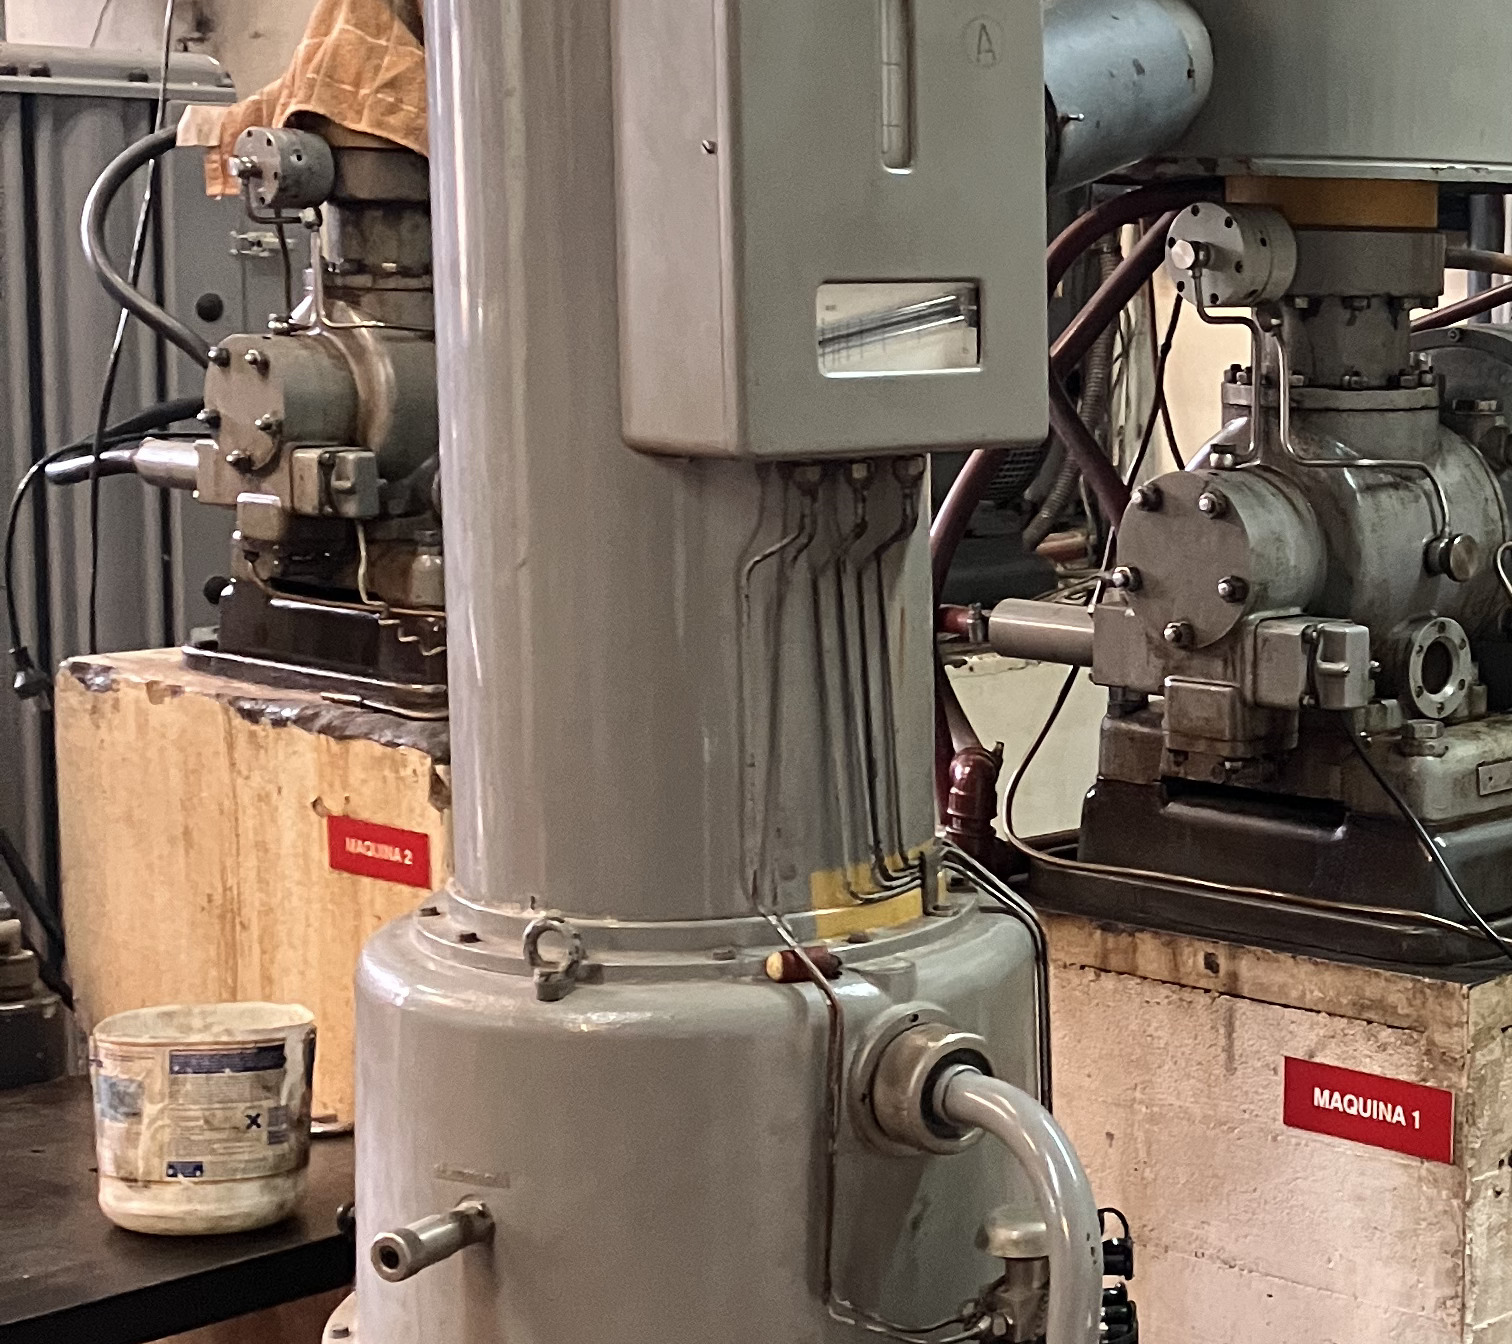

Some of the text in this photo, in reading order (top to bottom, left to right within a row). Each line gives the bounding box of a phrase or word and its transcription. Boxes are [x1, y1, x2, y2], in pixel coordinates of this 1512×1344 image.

[403, 848, 414, 865] 2
[1313, 1086, 1421, 1130] MAQUINA 1
